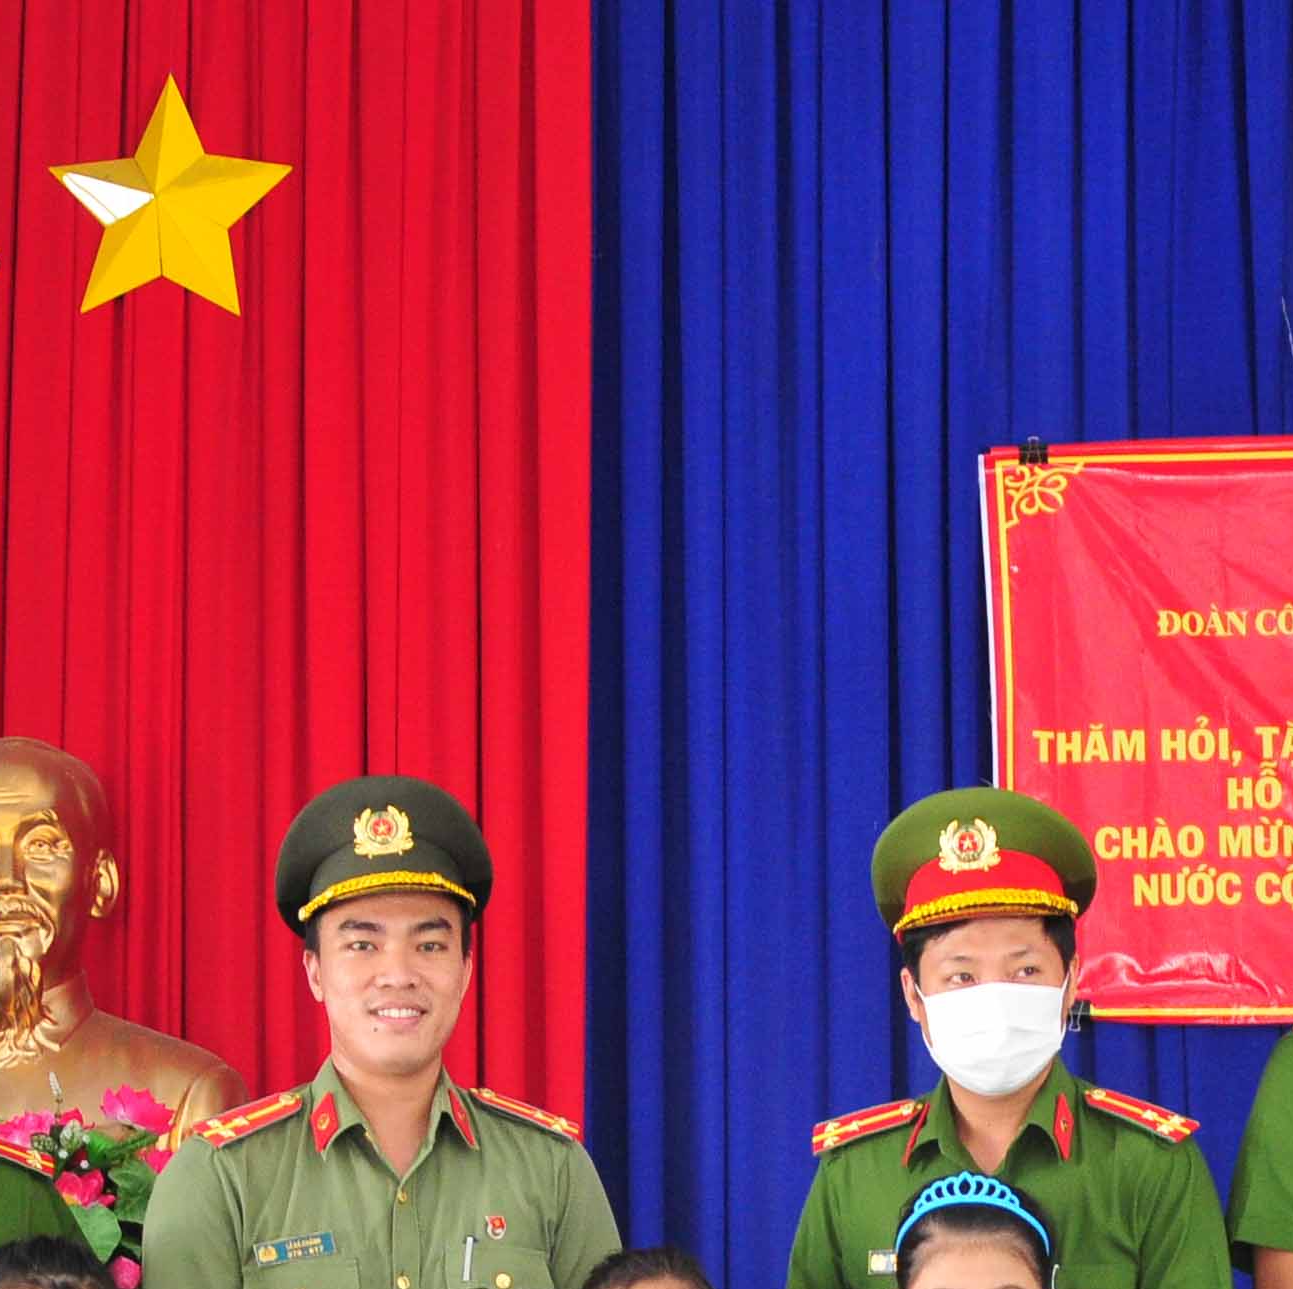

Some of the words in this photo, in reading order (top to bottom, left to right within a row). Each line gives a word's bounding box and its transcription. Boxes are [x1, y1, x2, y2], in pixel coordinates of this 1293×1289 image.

[1157, 606, 1248, 638] ĐOÀN
[1032, 720, 1147, 765] THĂM
[1164, 716, 1242, 768] HỎI,
[1226, 762, 1285, 811] HỖ
[1094, 816, 1206, 861] CHÀO
[1132, 856, 1243, 907] NƯỚC
